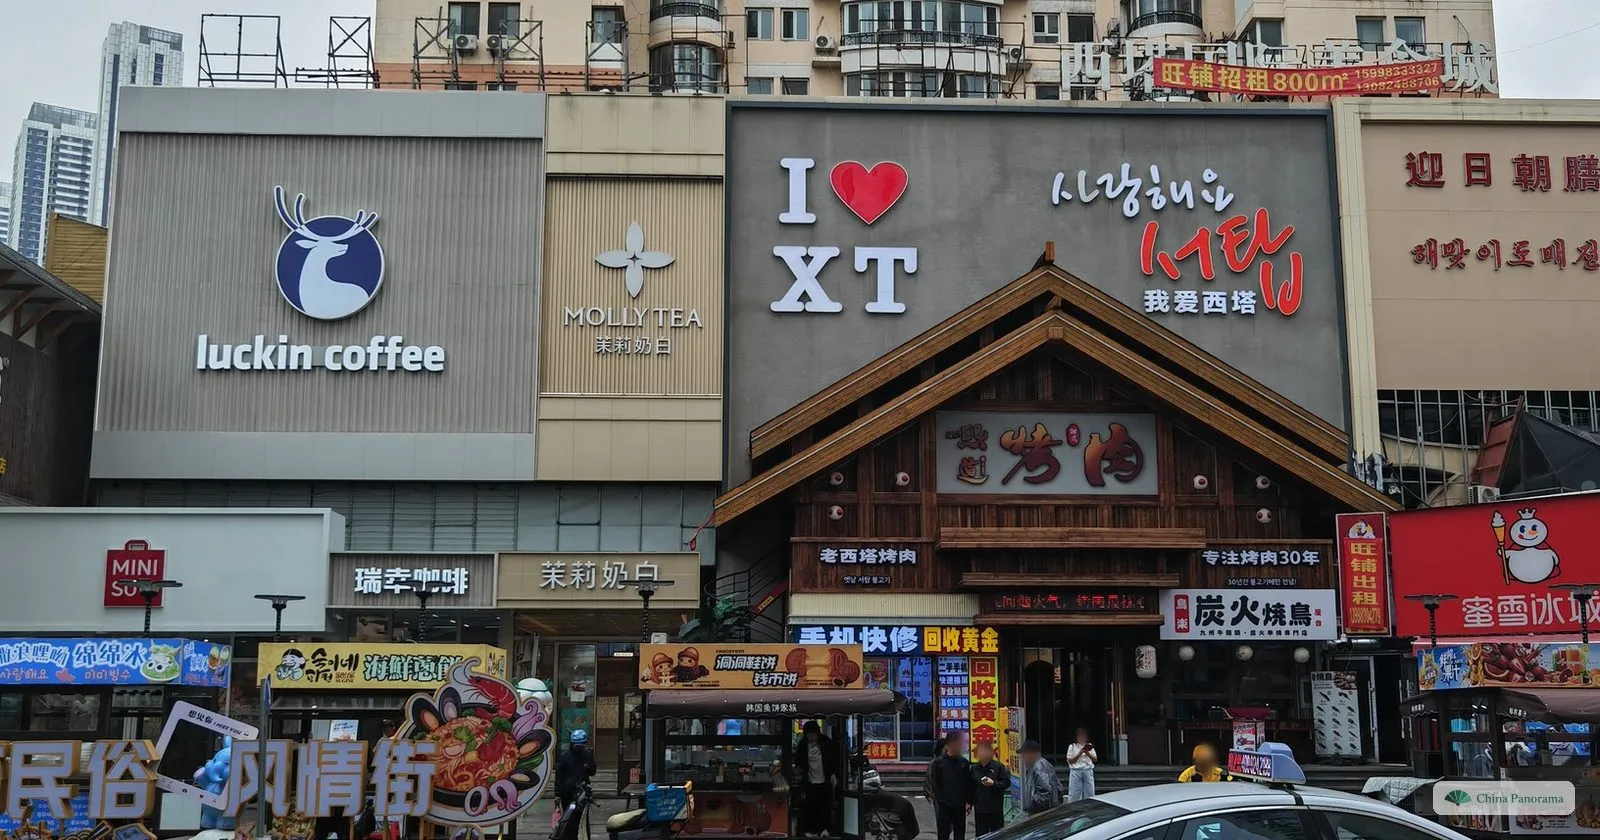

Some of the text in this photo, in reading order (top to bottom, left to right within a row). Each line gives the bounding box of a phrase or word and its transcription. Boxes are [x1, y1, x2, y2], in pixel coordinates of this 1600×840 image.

[1405, 151, 1600, 192] 迎日朝膳
[778, 158, 817, 224] I
[1051, 162, 1235, 218] 사랑해요
[1143, 289, 1257, 315] 我爱西塔
[563, 306, 703, 329] MOLLY TEA
[196, 333, 445, 371] luckin coffee
[595, 336, 672, 355] 茉莉奶白
[112, 559, 158, 576] MINI
[819, 548, 917, 565] 老西塔烤肉
[1202, 550, 1321, 566] 专注烤肉30年
[354, 567, 469, 595] 瑞幸咖啡
[539, 560, 660, 590] 茉莉奶白
[1350, 542, 1379, 605] 旺铺出租
[799, 626, 919, 653] 手机快修
[923, 626, 1000, 653] 回收黄金
[971, 657, 997, 758] 回收黄金
